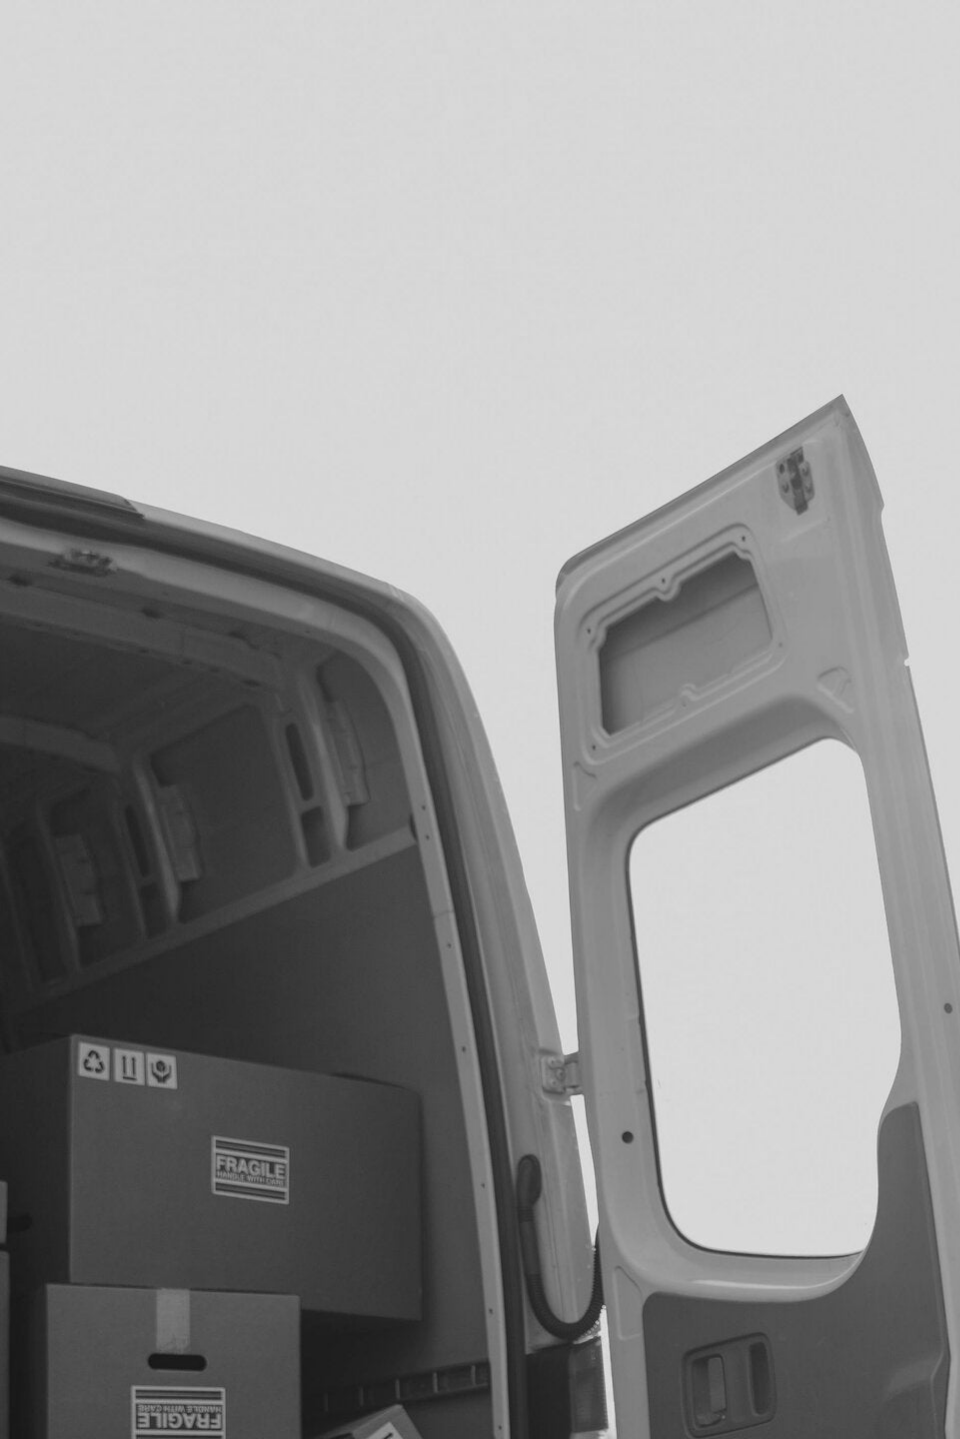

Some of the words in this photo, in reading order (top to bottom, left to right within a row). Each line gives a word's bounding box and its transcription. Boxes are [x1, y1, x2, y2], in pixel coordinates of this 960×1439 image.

[216, 1155, 286, 1180] FRAGILE
[138, 1404, 162, 1412] CARE
[164, 1404, 186, 1413] WITH
[188, 1404, 222, 1413] HANDLE
[138, 1412, 222, 1429] FRAGILE
